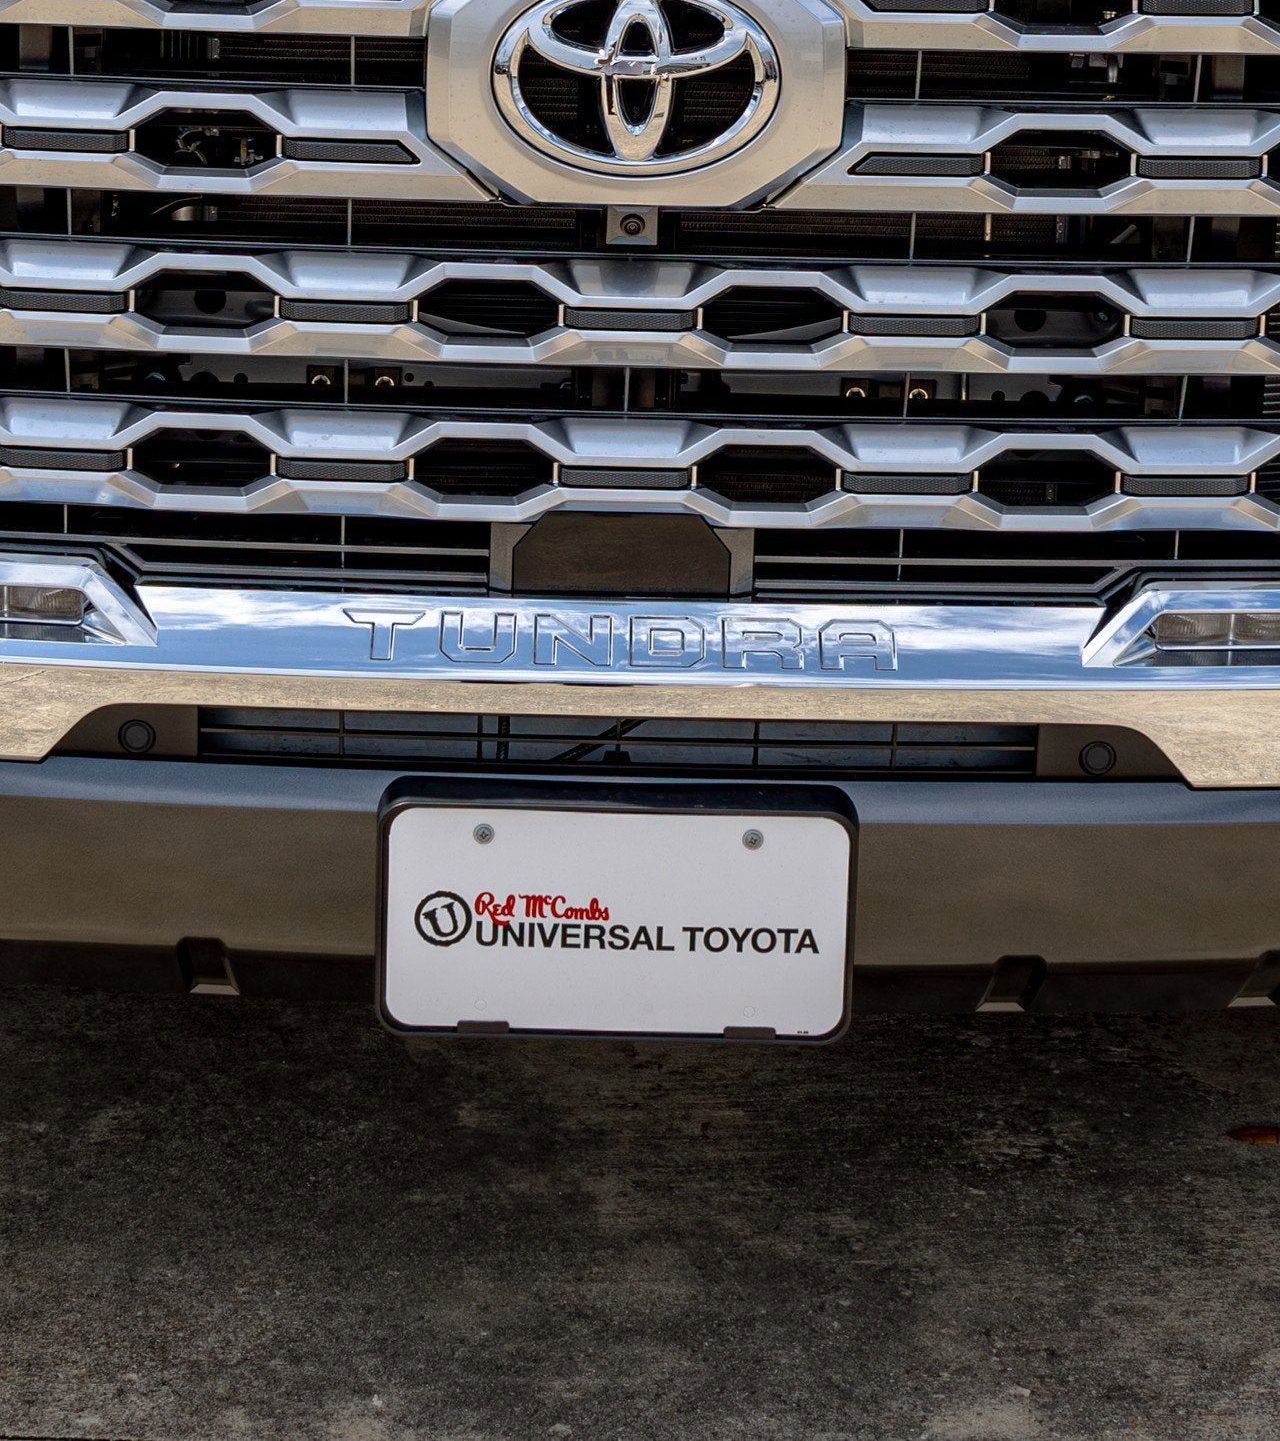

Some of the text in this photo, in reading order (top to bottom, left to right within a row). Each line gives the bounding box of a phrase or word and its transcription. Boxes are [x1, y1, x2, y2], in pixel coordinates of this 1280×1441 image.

[341, 606, 898, 672] TUNDRA
[474, 891, 610, 927] Red McCombs
[475, 922, 820, 955] UNIVERSAL TOYOTA
